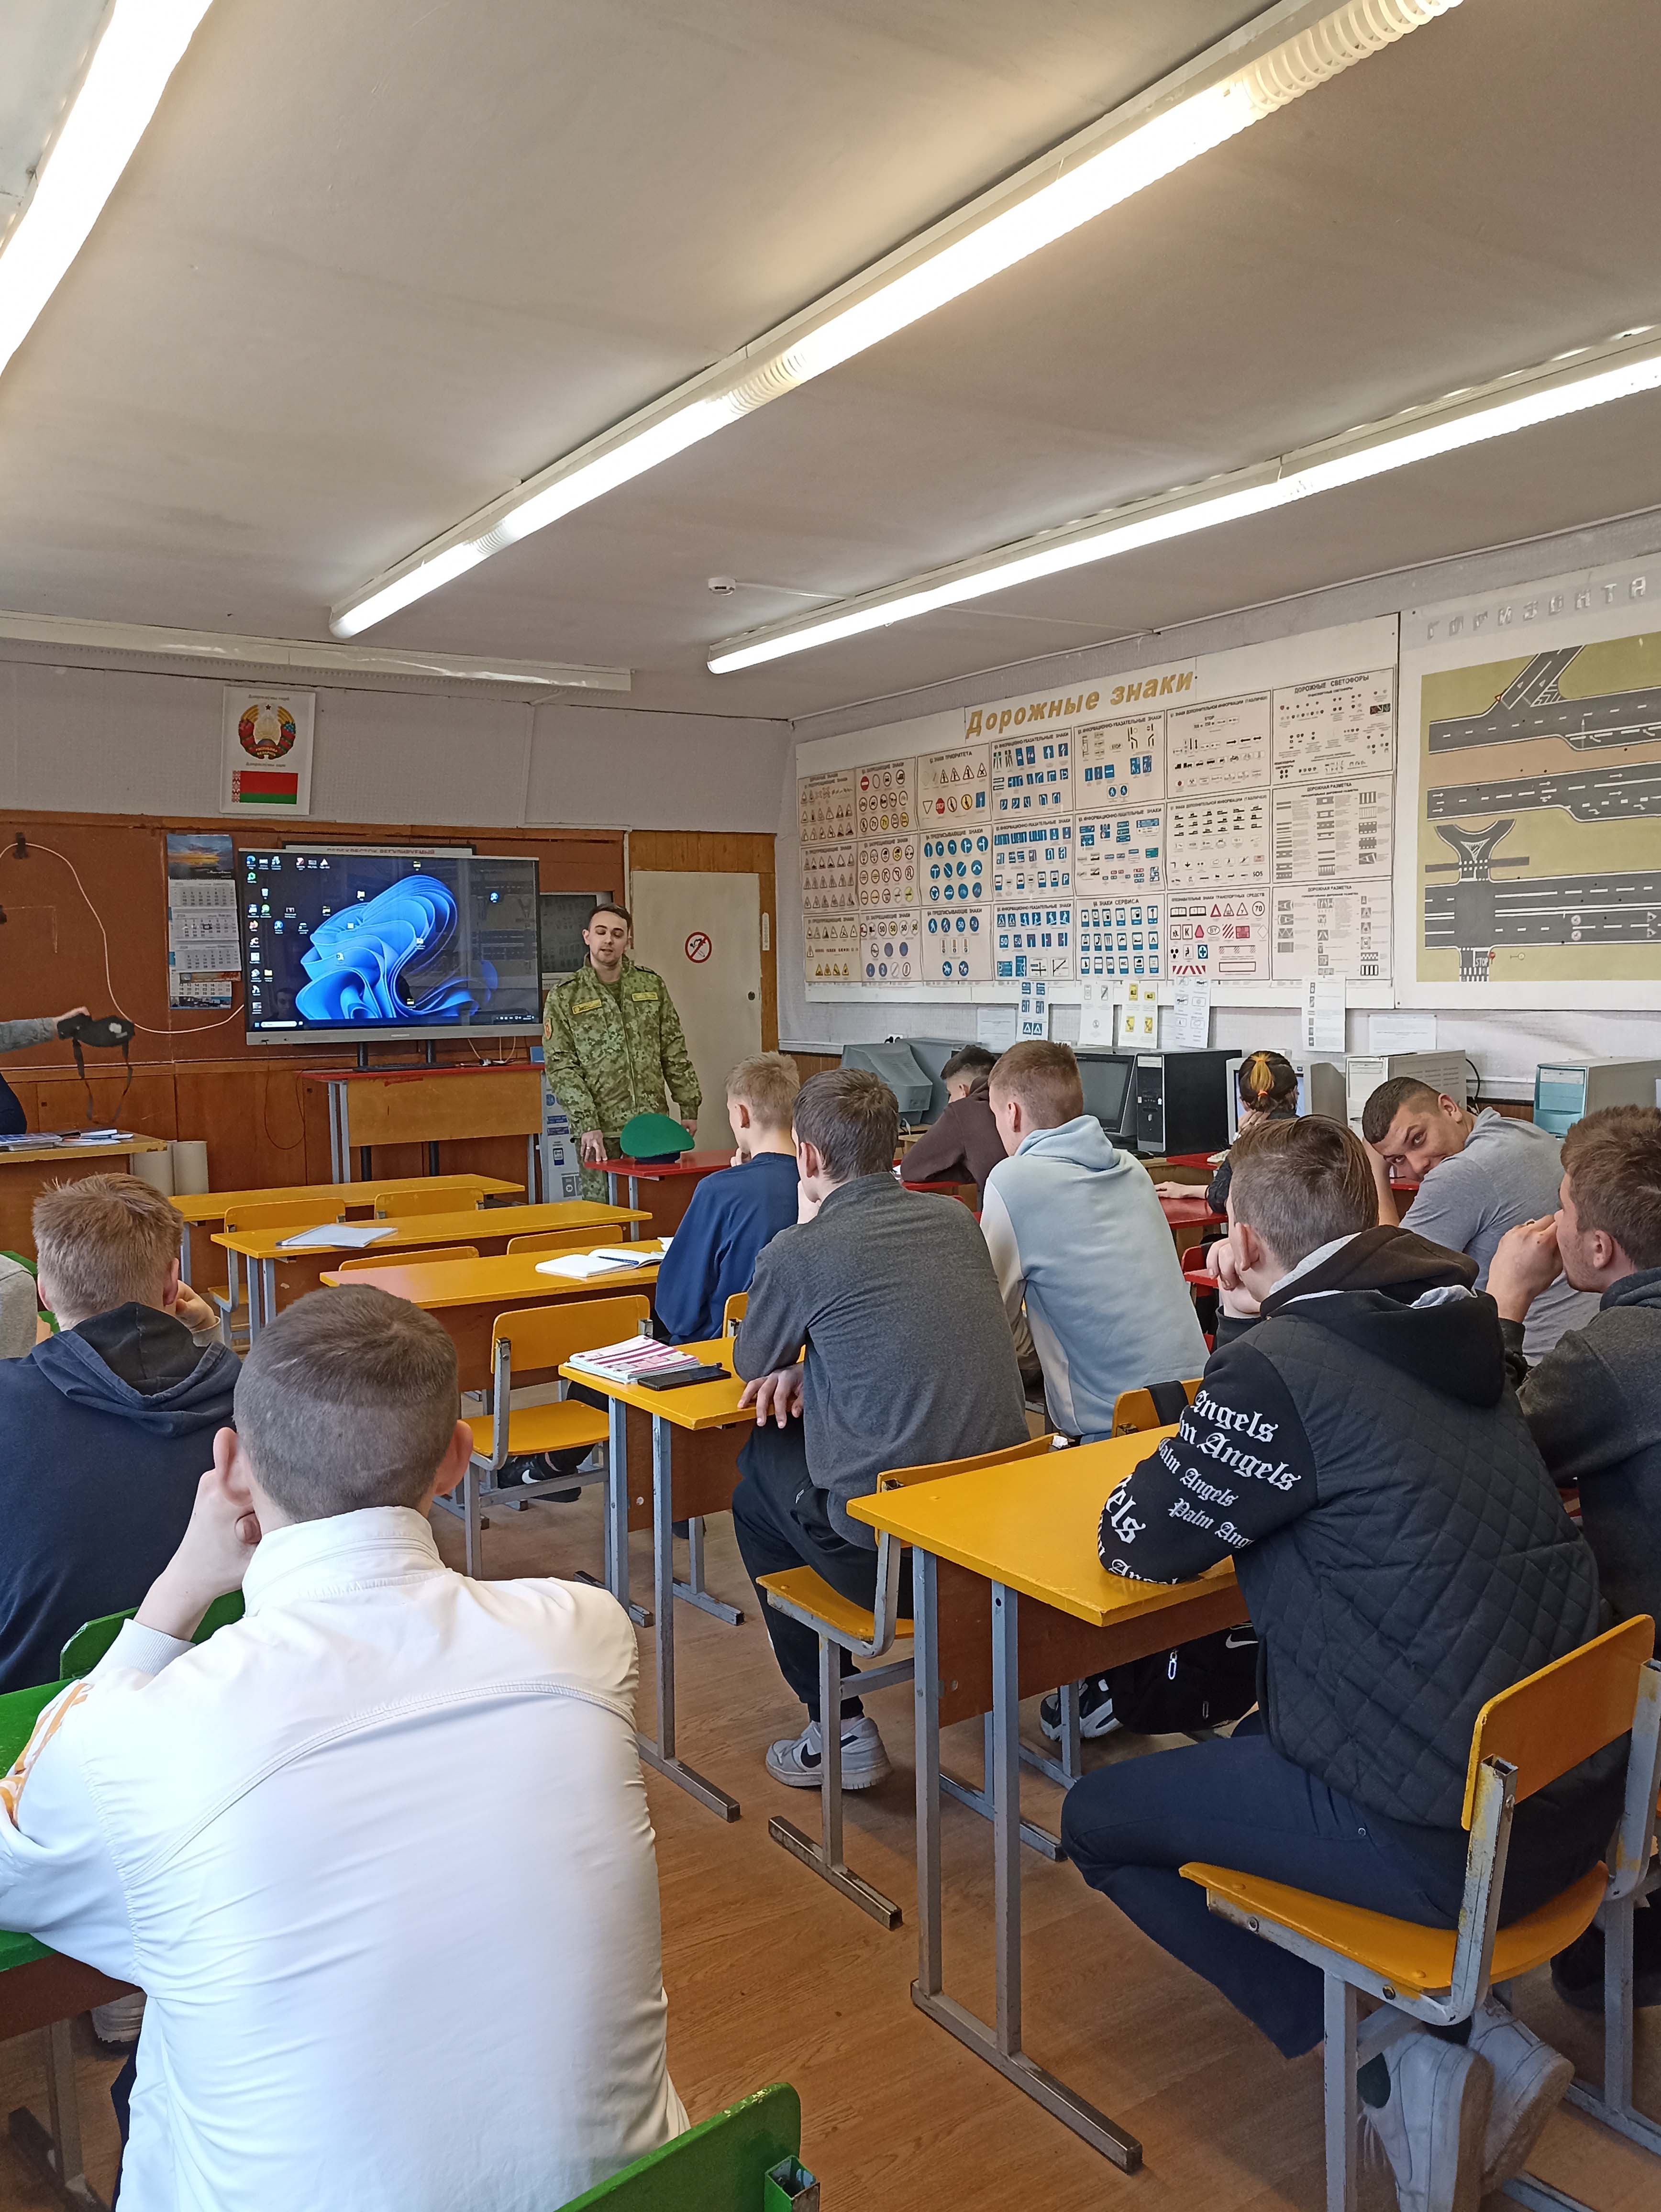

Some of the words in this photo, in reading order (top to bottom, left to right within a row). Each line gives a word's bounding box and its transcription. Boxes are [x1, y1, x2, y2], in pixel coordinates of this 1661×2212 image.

[1294, 682, 1327, 694] ДОРОЖНЫЕ
[1330, 675, 1369, 686] СВЕТОФОРЫ
[965, 690, 1099, 739] Дорожные
[1110, 671, 1193, 705] знаки
[945, 751, 972, 761] ПРИОРИТЕТА
[1475, 957, 1488, 967] STOP
[1196, 1432, 1302, 1491] Angels
[1180, 1468, 1239, 1507] Angels
[1168, 1498, 1215, 1529] Palm
